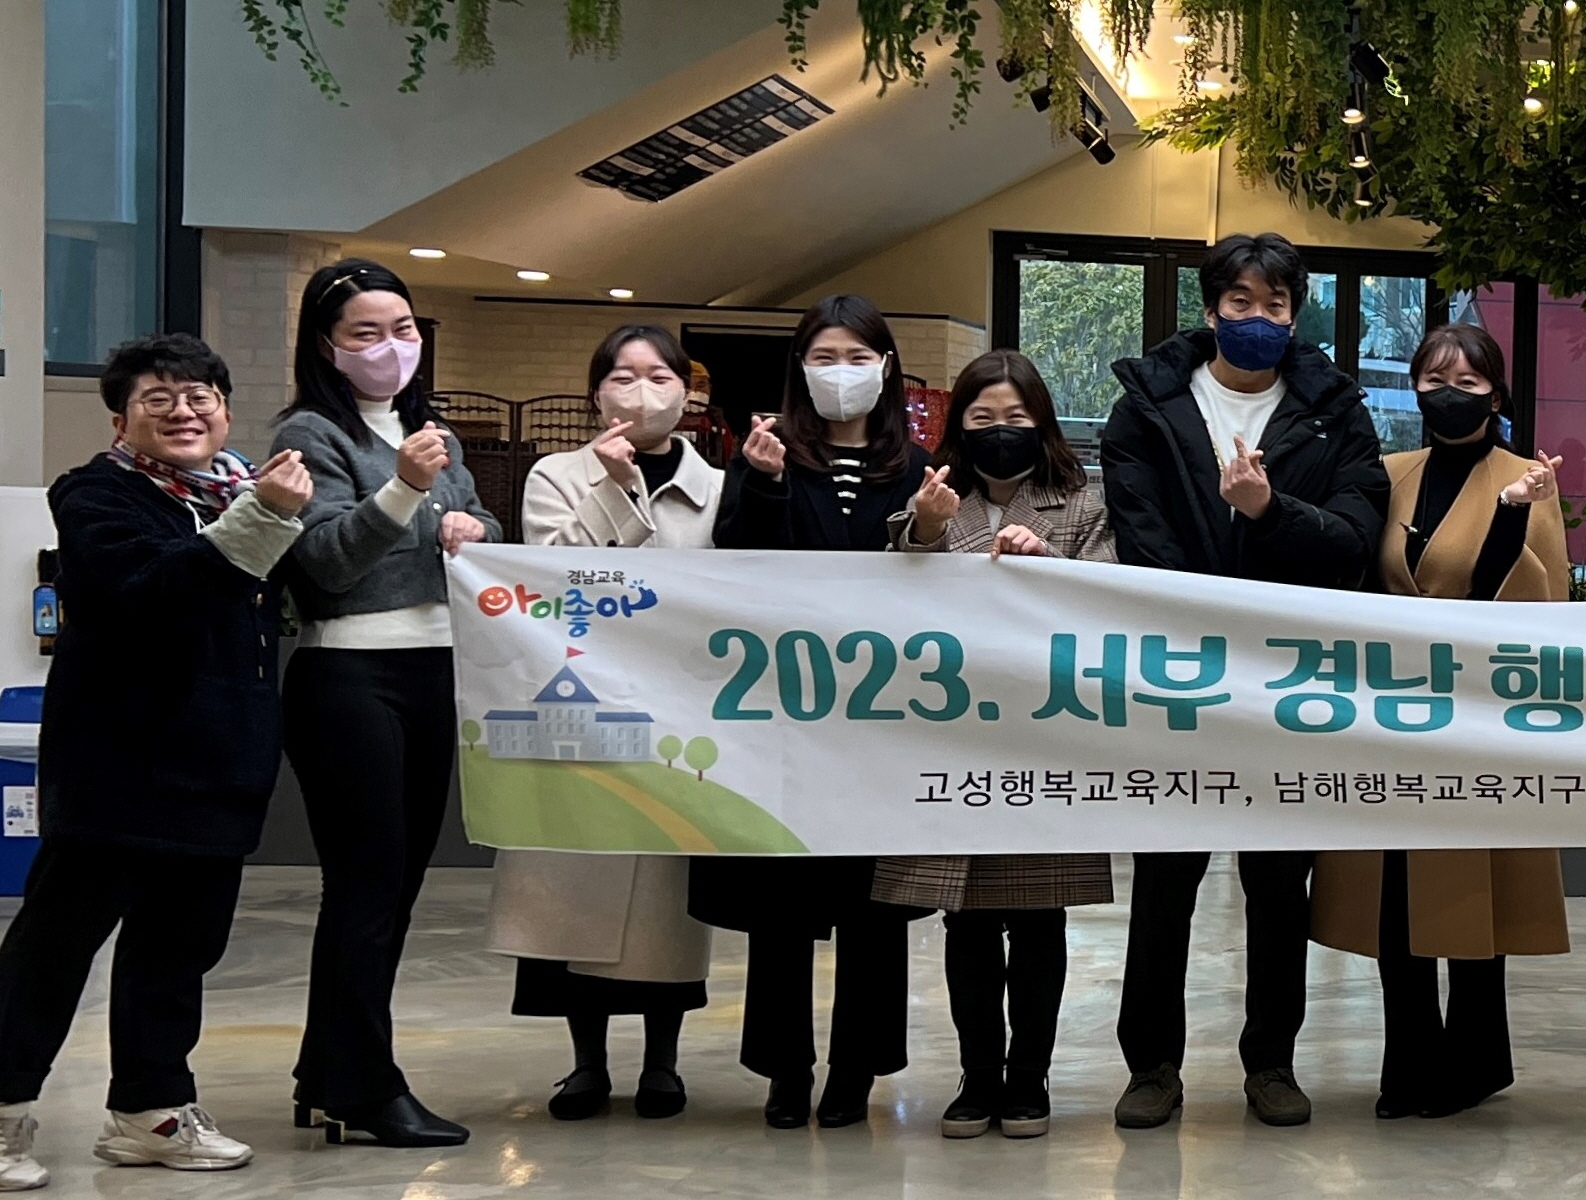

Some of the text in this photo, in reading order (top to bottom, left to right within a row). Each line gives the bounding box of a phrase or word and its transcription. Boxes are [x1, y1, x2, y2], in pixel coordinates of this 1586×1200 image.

[567, 570, 625, 585] 경남교육
[477, 583, 658, 638] 아이좋아
[708, 628, 1000, 721] 2023.
[1032, 632, 1232, 731] 서부
[1264, 637, 1463, 734] 경남
[914, 768, 1254, 807] 고성행복교육지구,
